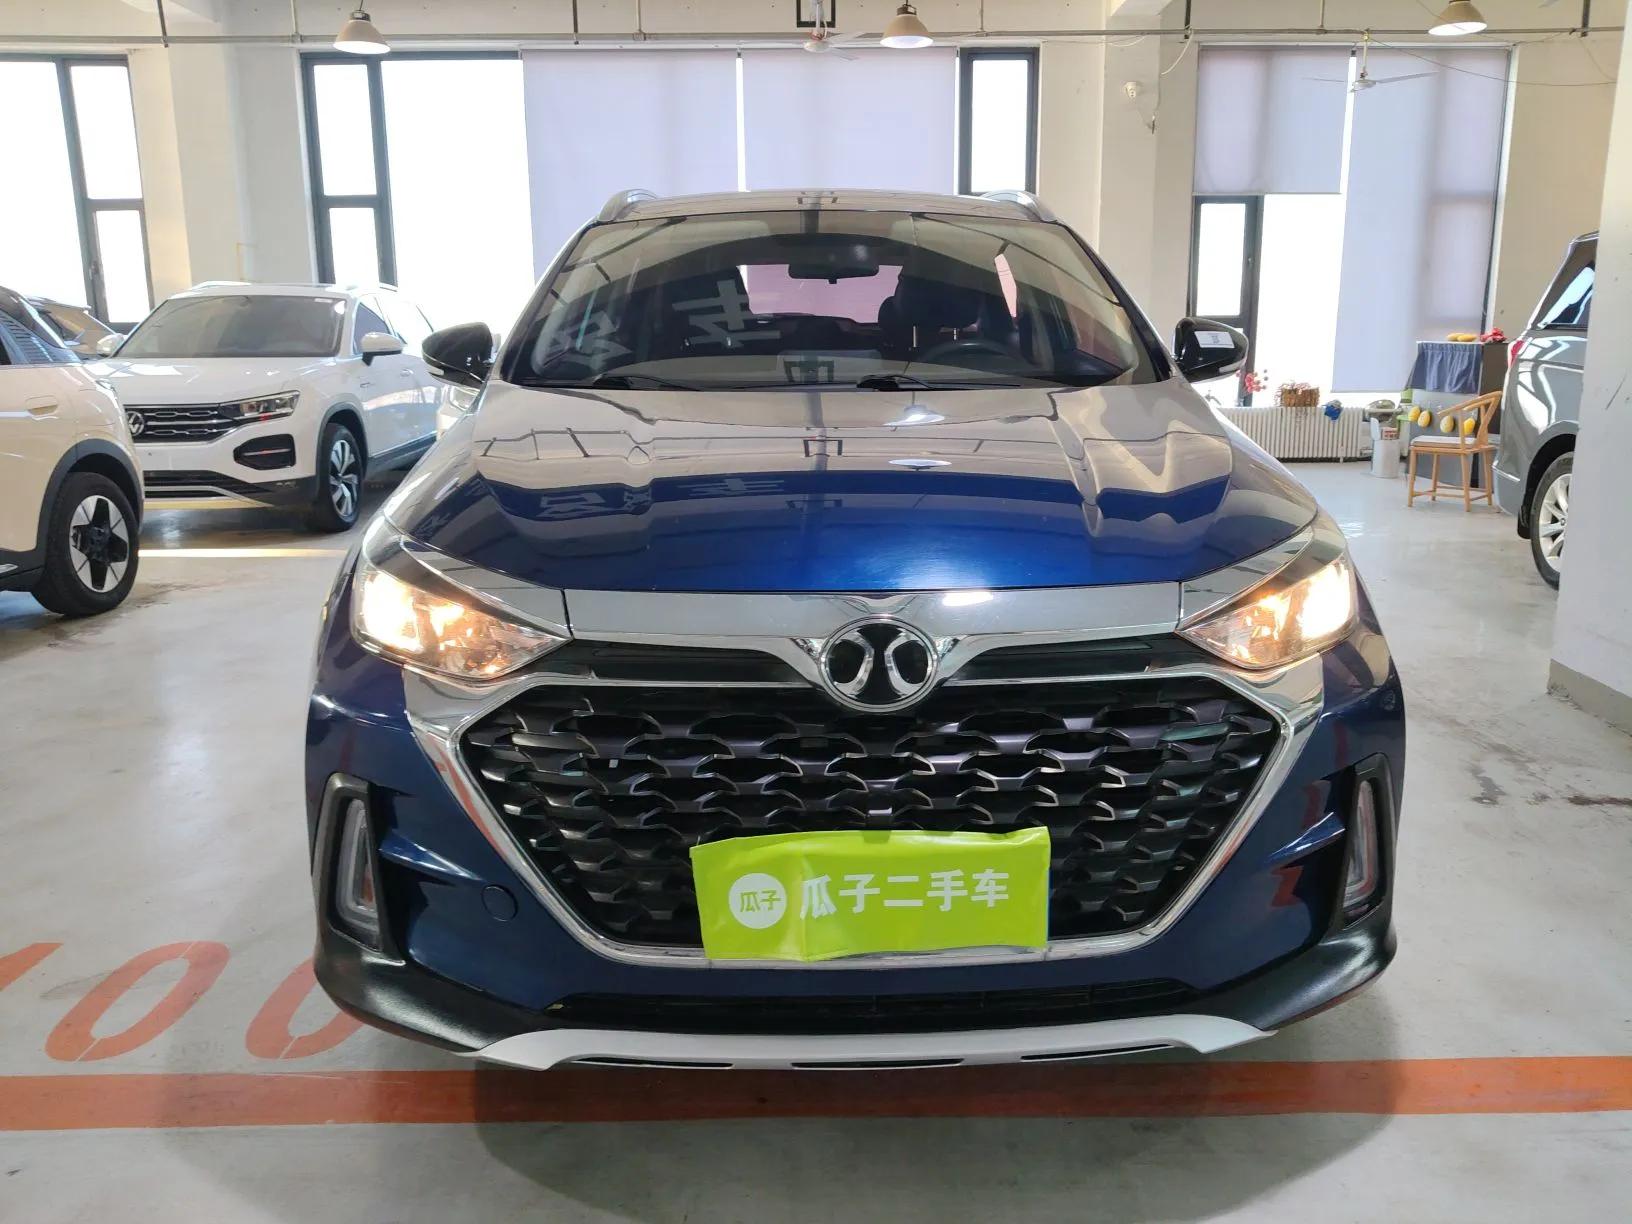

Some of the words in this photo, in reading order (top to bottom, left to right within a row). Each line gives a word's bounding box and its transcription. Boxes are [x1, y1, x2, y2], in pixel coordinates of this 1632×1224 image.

[740, 889, 782, 912] 瓜子
[800, 868, 1009, 920] 瓜子二手车
